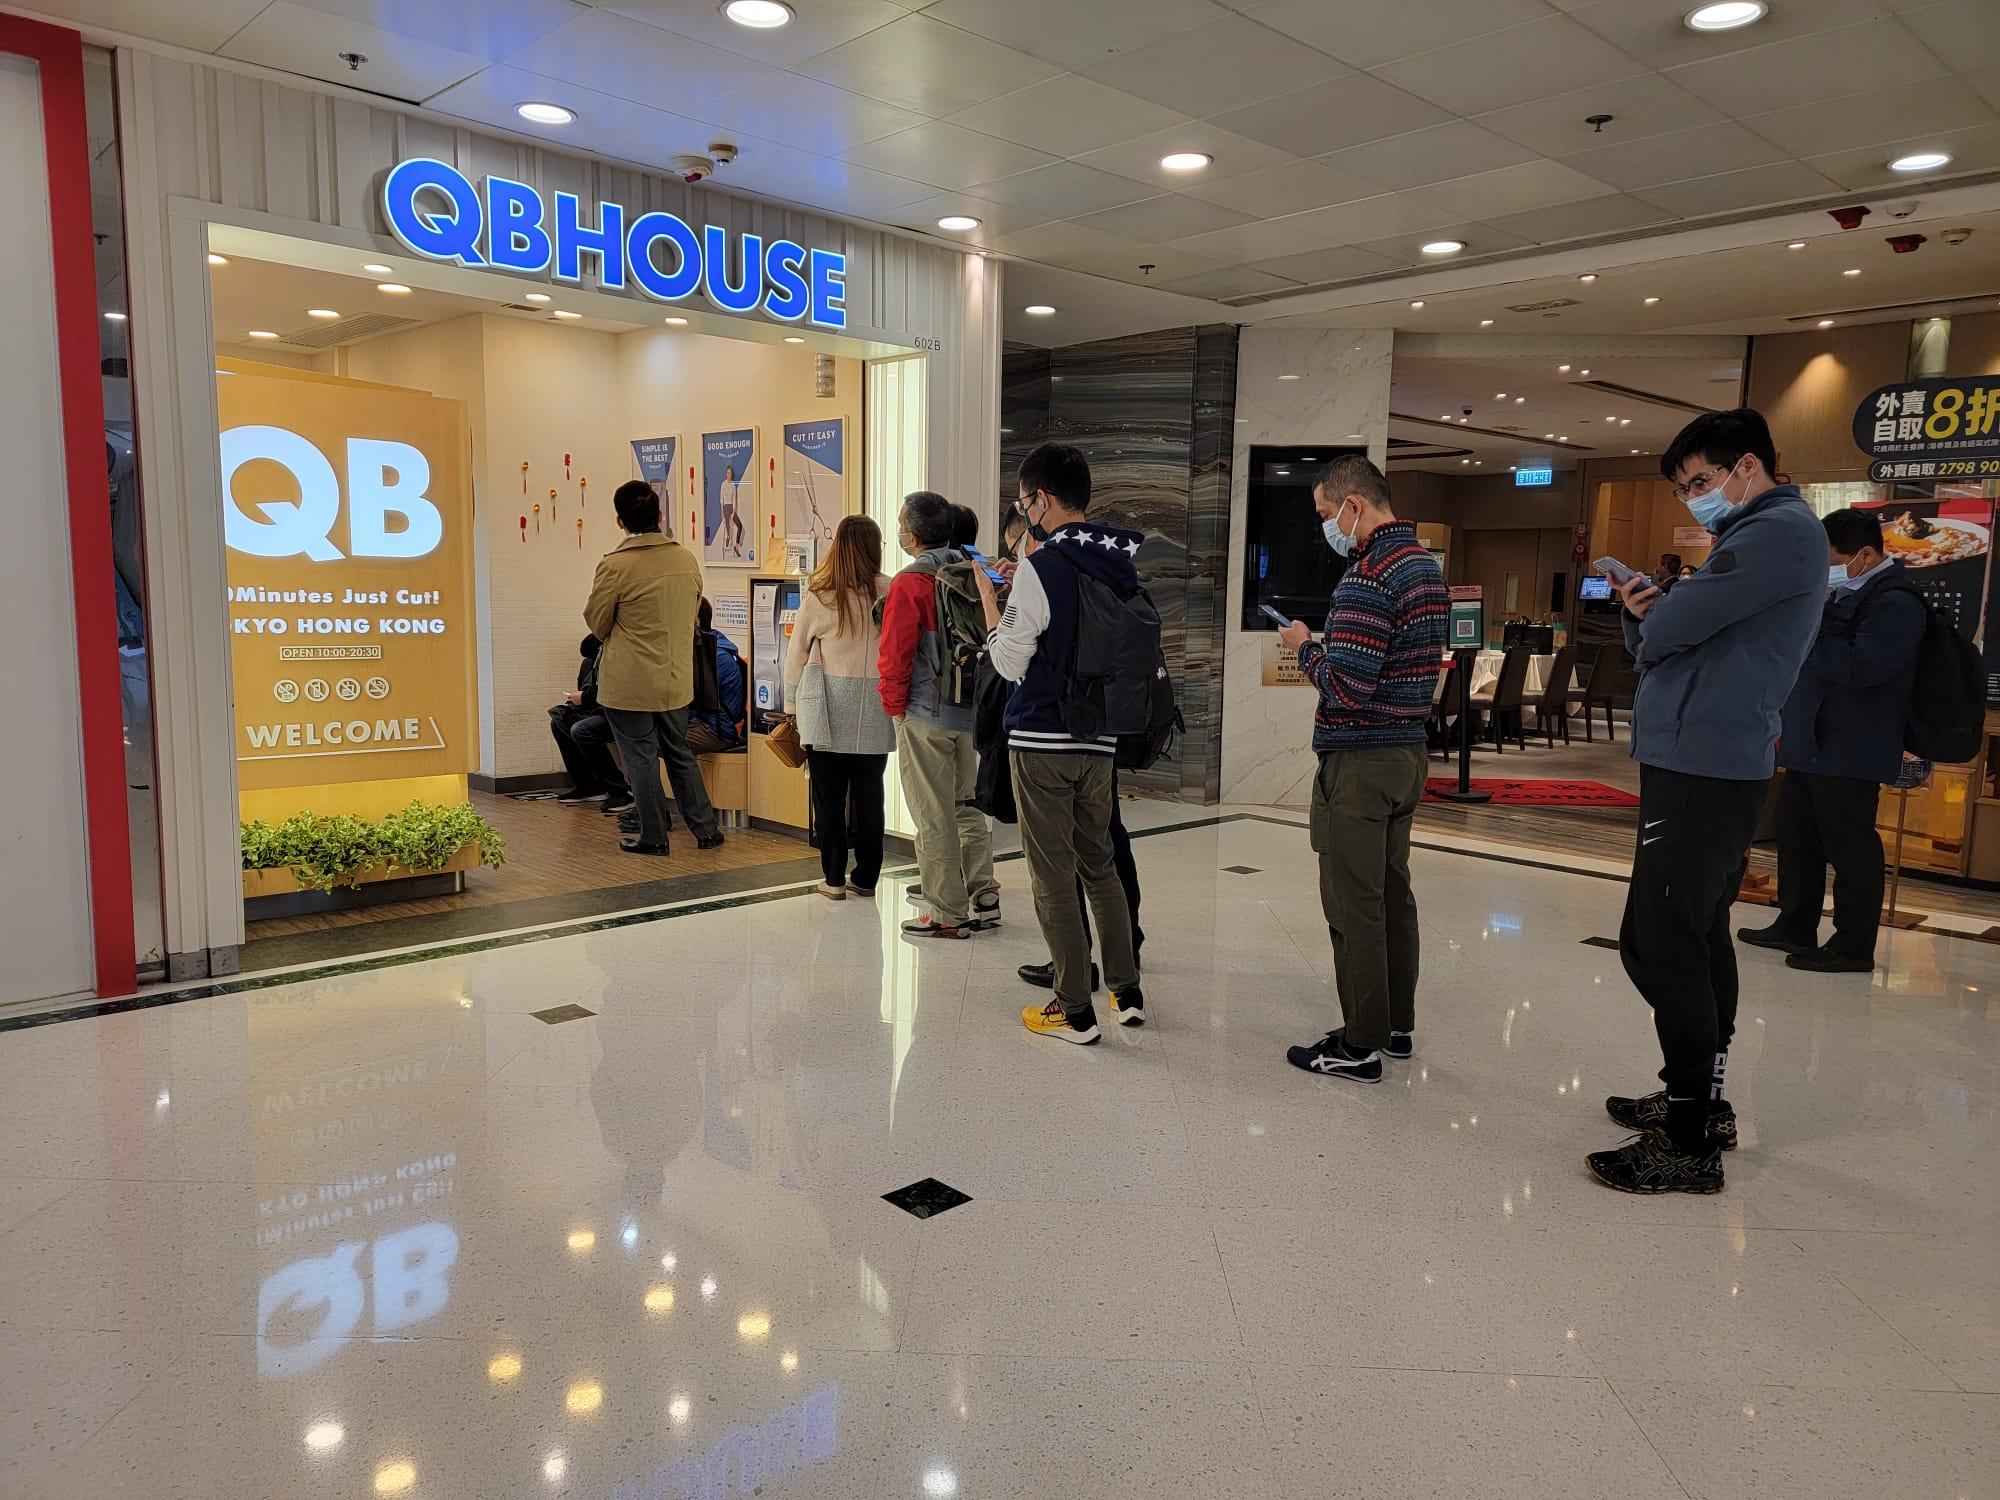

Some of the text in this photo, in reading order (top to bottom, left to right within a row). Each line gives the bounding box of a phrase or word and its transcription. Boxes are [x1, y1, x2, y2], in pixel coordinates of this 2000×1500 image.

[383, 157, 847, 330] QBHOUSE
[914, 336, 941, 351] 602B
[1875, 390, 1927, 418] 外賣
[792, 429, 836, 442] CUT IT EASY
[1873, 417, 1924, 442] 自取
[641, 443, 669, 453] SIMPLE IS
[707, 439, 751, 450] GOOD ENOUGH
[653, 453, 668, 461] BEST
[1880, 460, 2000, 478] 外賣自取 2798 90
[220, 424, 443, 562] QB
[342, 588, 388, 604] Just
[396, 589, 440, 605] Cut!
[230, 618, 446, 634] KYO HONG KONG
[282, 647, 379, 658] OPEN 10:00-20:30
[245, 717, 421, 748] WELCOME
